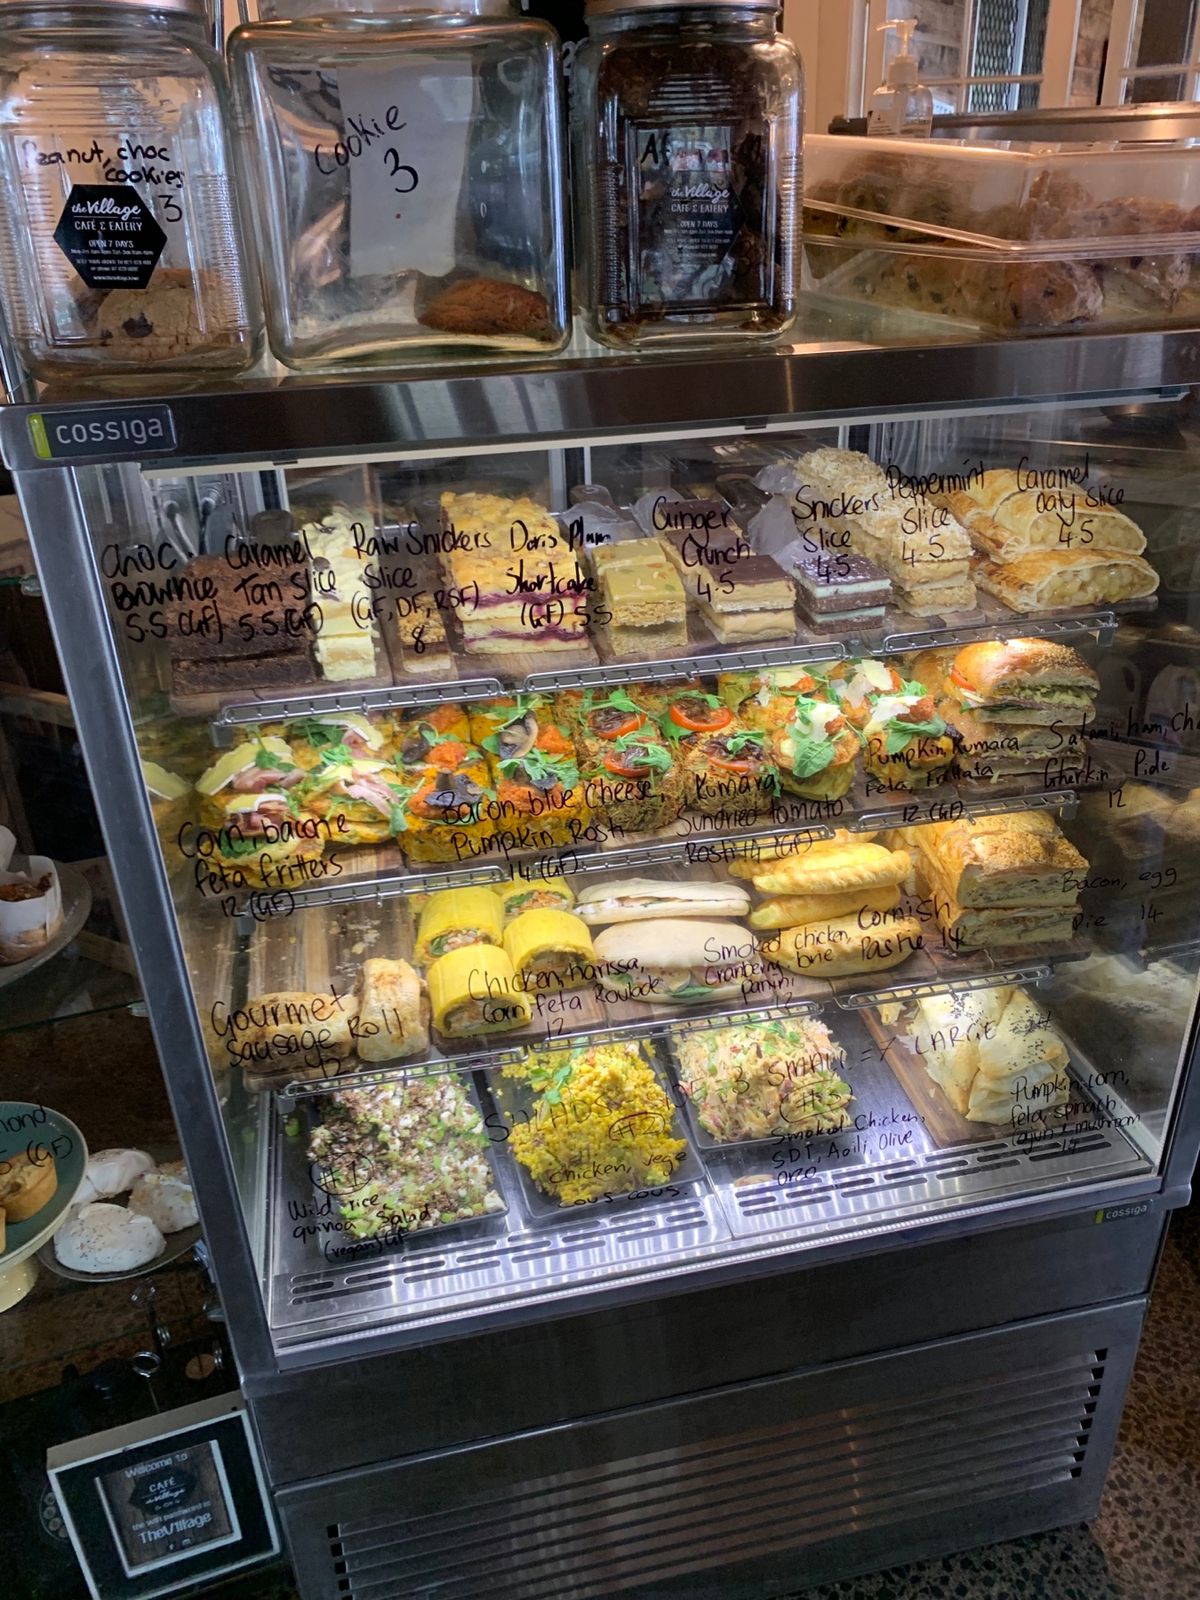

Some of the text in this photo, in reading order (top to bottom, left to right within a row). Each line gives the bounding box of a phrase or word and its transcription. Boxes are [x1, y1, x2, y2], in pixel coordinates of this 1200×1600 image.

[117, 140, 170, 162] choc
[384, 148, 419, 193] 3
[158, 194, 183, 222] 3
[109, 222, 142, 231] EATERY
[115, 240, 134, 248] DAYS
[56, 418, 164, 445] cossiga
[885, 458, 985, 507] Peppermint
[1016, 452, 1089, 492] Caramel
[791, 484, 880, 520] Snickers
[652, 495, 731, 548] Ginger
[901, 507, 951, 535] Slice
[1058, 519, 1095, 548] 4.5
[350, 520, 492, 560] Raw Snickers
[510, 519, 558, 553] Doris
[682, 533, 751, 567] Crunch
[802, 526, 853, 553] Slice
[225, 530, 315, 571] Caramel
[902, 534, 945, 568] 4.5
[362, 567, 417, 590] Slice
[816, 554, 851, 584] 4.5
[234, 573, 283, 606] Tan
[697, 570, 735, 603] 4.5
[411, 627, 426, 654] 8
[1044, 749, 1170, 789] Gherkin Pide
[528, 788, 576, 816] blue
[770, 794, 844, 824] tomato
[1108, 789, 1126, 808] 12
[902, 805, 922, 823] 12
[261, 818, 332, 845] bacon
[450, 828, 553, 861] Pumpkin
[509, 861, 530, 881] 14
[1138, 867, 1177, 889] egg
[221, 896, 246, 918] 12
[857, 901, 951, 930] Cornish
[1141, 904, 1164, 923] 14
[703, 928, 783, 963] Smoked
[938, 926, 966, 951] 14
[211, 984, 347, 1040] Gourmet
[347, 1007, 404, 1039] Roll
[546, 1017, 571, 1040] 12
[27, 1135, 73, 1167] (GF)
[288, 1195, 332, 1220] Wild
[1106, 1205, 1147, 1219] cossiga
[293, 1221, 357, 1244] quinoa
[124, 1453, 188, 1478] Welcome to
